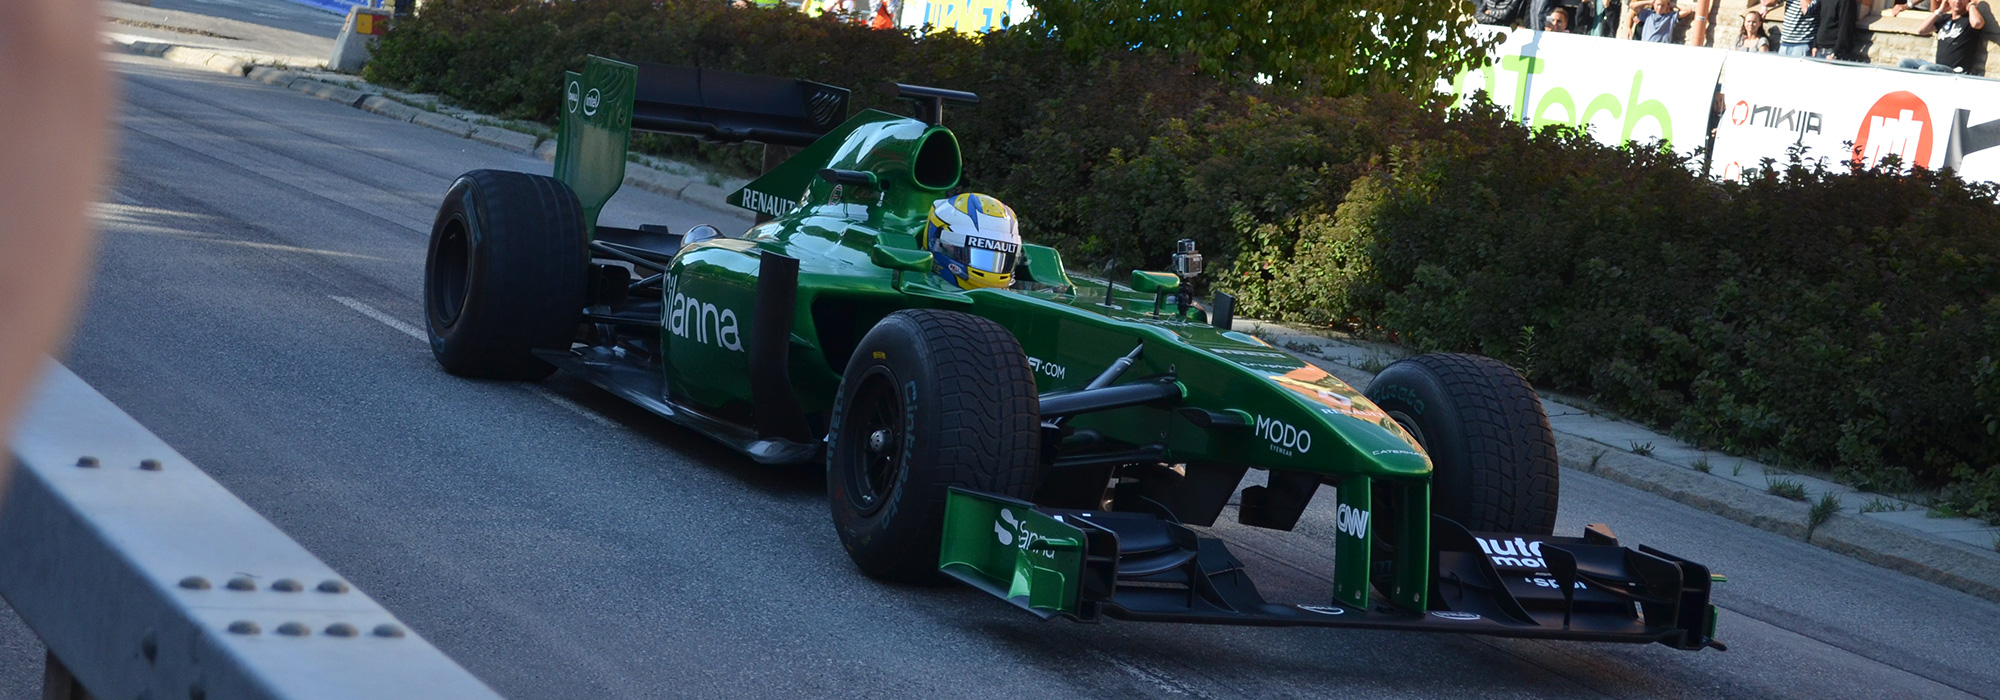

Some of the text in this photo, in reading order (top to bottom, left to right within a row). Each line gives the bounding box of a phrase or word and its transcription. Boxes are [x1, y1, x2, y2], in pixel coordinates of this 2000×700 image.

[968, 236, 1017, 254] RENAULT
[661, 271, 745, 353] Silanna
[1255, 414, 1311, 453] MODO
[1269, 444, 1293, 457] EYEWEAR
[1336, 503, 1369, 539] CNN
